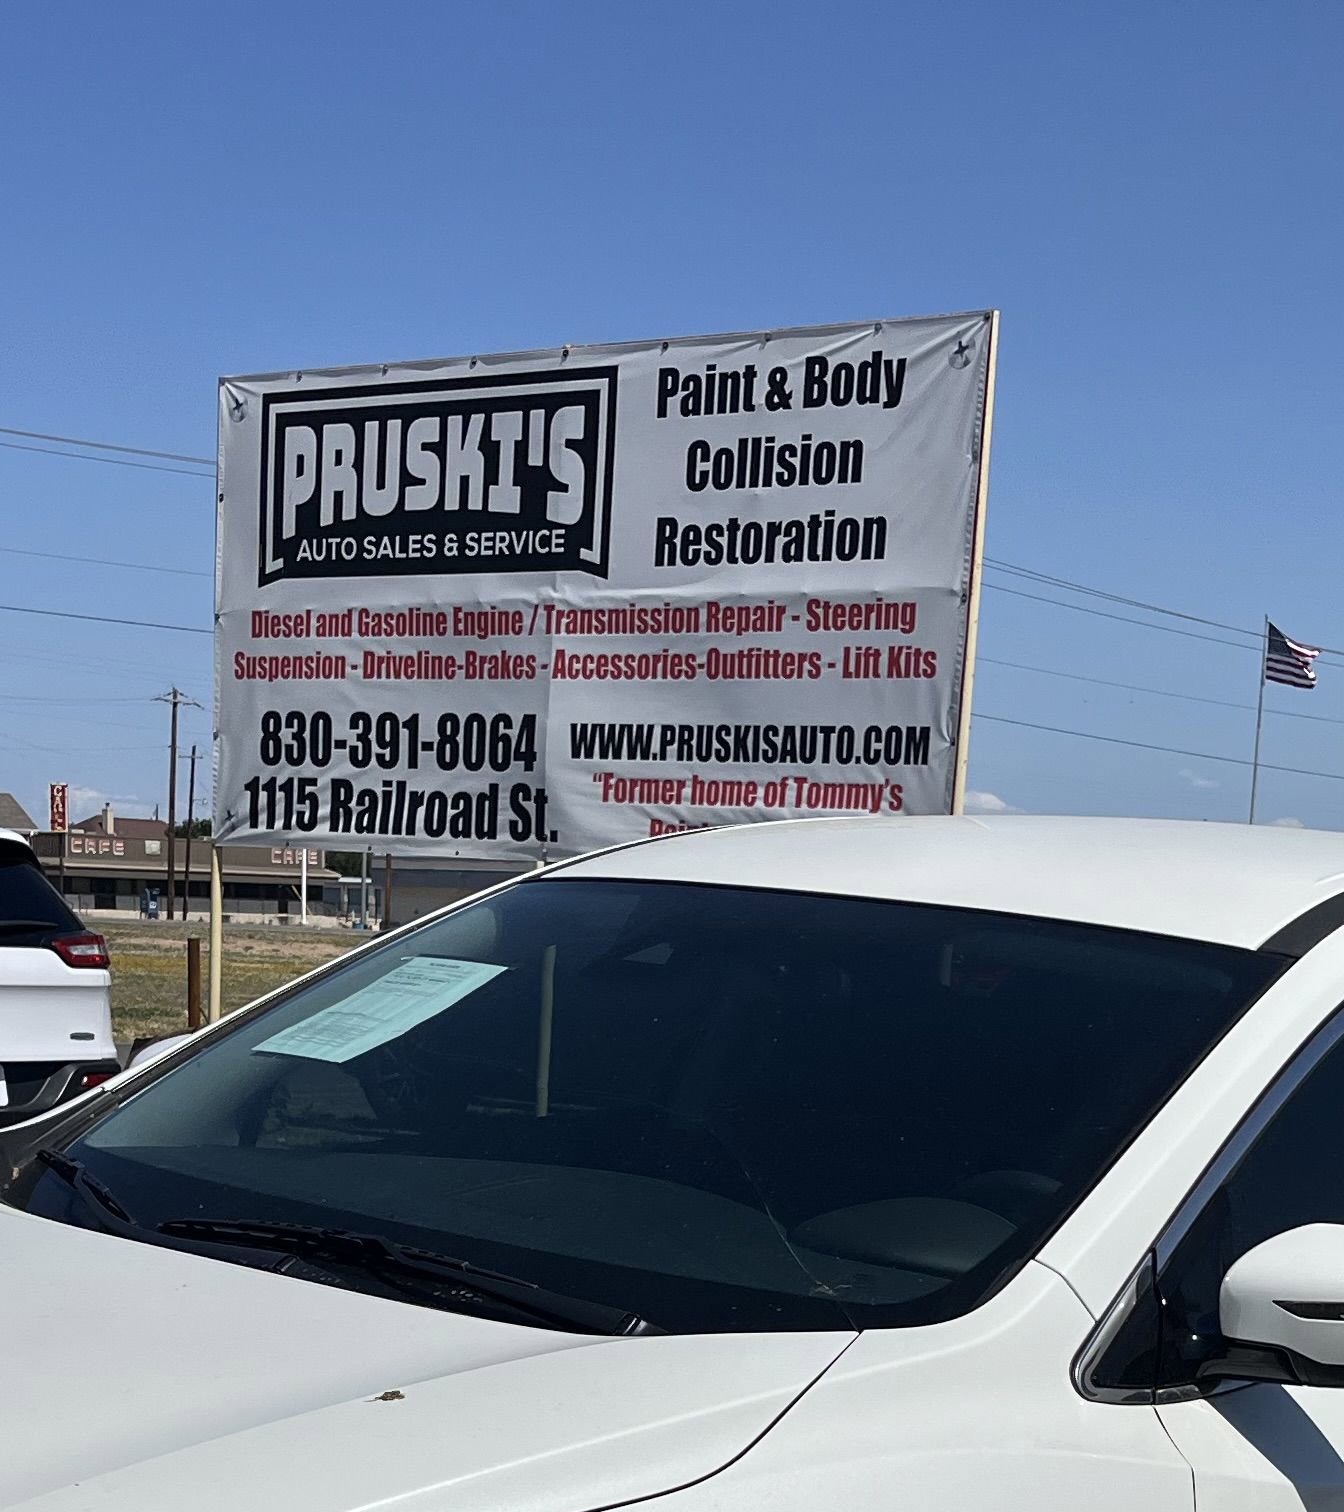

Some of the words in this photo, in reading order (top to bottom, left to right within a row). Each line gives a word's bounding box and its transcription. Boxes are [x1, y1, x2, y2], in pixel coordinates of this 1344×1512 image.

[656, 363, 758, 419] Paint
[764, 366, 793, 412] &
[802, 350, 907, 410] Body
[282, 405, 586, 540] PRUSKI'S
[686, 433, 864, 492] Collision
[296, 537, 357, 562] AUTO
[362, 533, 437, 560] SALES
[443, 533, 459, 557] &
[464, 528, 566, 557] SERVICE
[654, 509, 887, 567] Restoration
[251, 610, 312, 640] Diesel
[316, 608, 353, 638] and
[357, 606, 448, 638] Gasoline
[452, 604, 523, 640] Engine
[543, 602, 701, 635] Transmission
[705, 600, 786, 636] Repair
[806, 598, 917, 634] Steering
[234, 651, 346, 682] Suspension
[842, 646, 882, 680] Lift
[887, 645, 937, 680] Kits
[260, 710, 538, 773] 830-391-8064
[570, 723, 931, 766] WWW.PRUSKISAUTO.COM
[243, 775, 320, 832] 1115
[328, 778, 500, 841] Railroad
[508, 782, 559, 843] St.
[690, 774, 758, 807] home
[763, 776, 790, 808] of
[794, 775, 904, 814] Tommy's
[70, 837, 125, 856] CAFE
